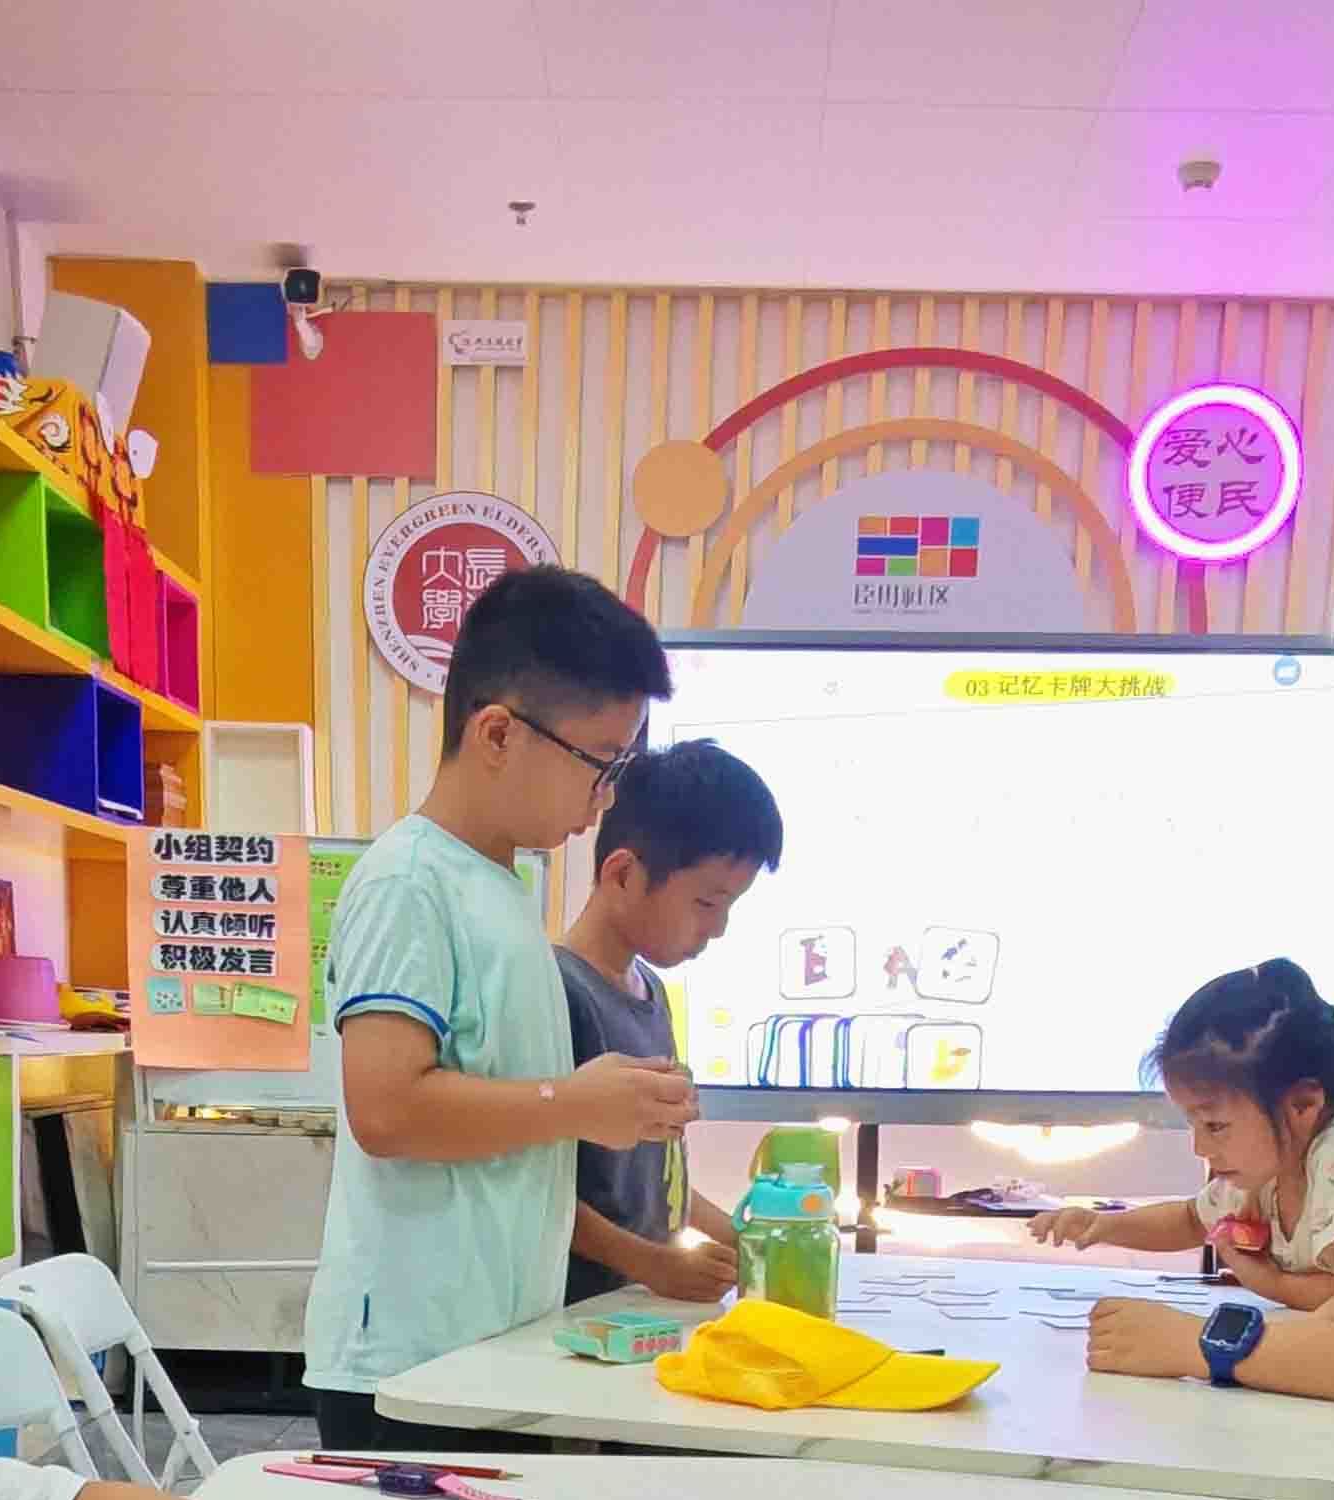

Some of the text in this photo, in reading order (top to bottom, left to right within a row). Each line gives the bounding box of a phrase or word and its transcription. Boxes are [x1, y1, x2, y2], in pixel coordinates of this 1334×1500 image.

[1163, 427, 1266, 468] 爱心
[1162, 480, 1265, 518] 便民
[378, 502, 477, 574] EVERGREEN
[372, 574, 420, 672] SHENZHEN
[965, 674, 1167, 698] 03 记忆卡牌大挑战
[154, 833, 275, 864] 小组契约
[160, 874, 276, 903] 尊重他人
[160, 910, 276, 939] 认真倾听
[160, 944, 276, 974] 积极发言
